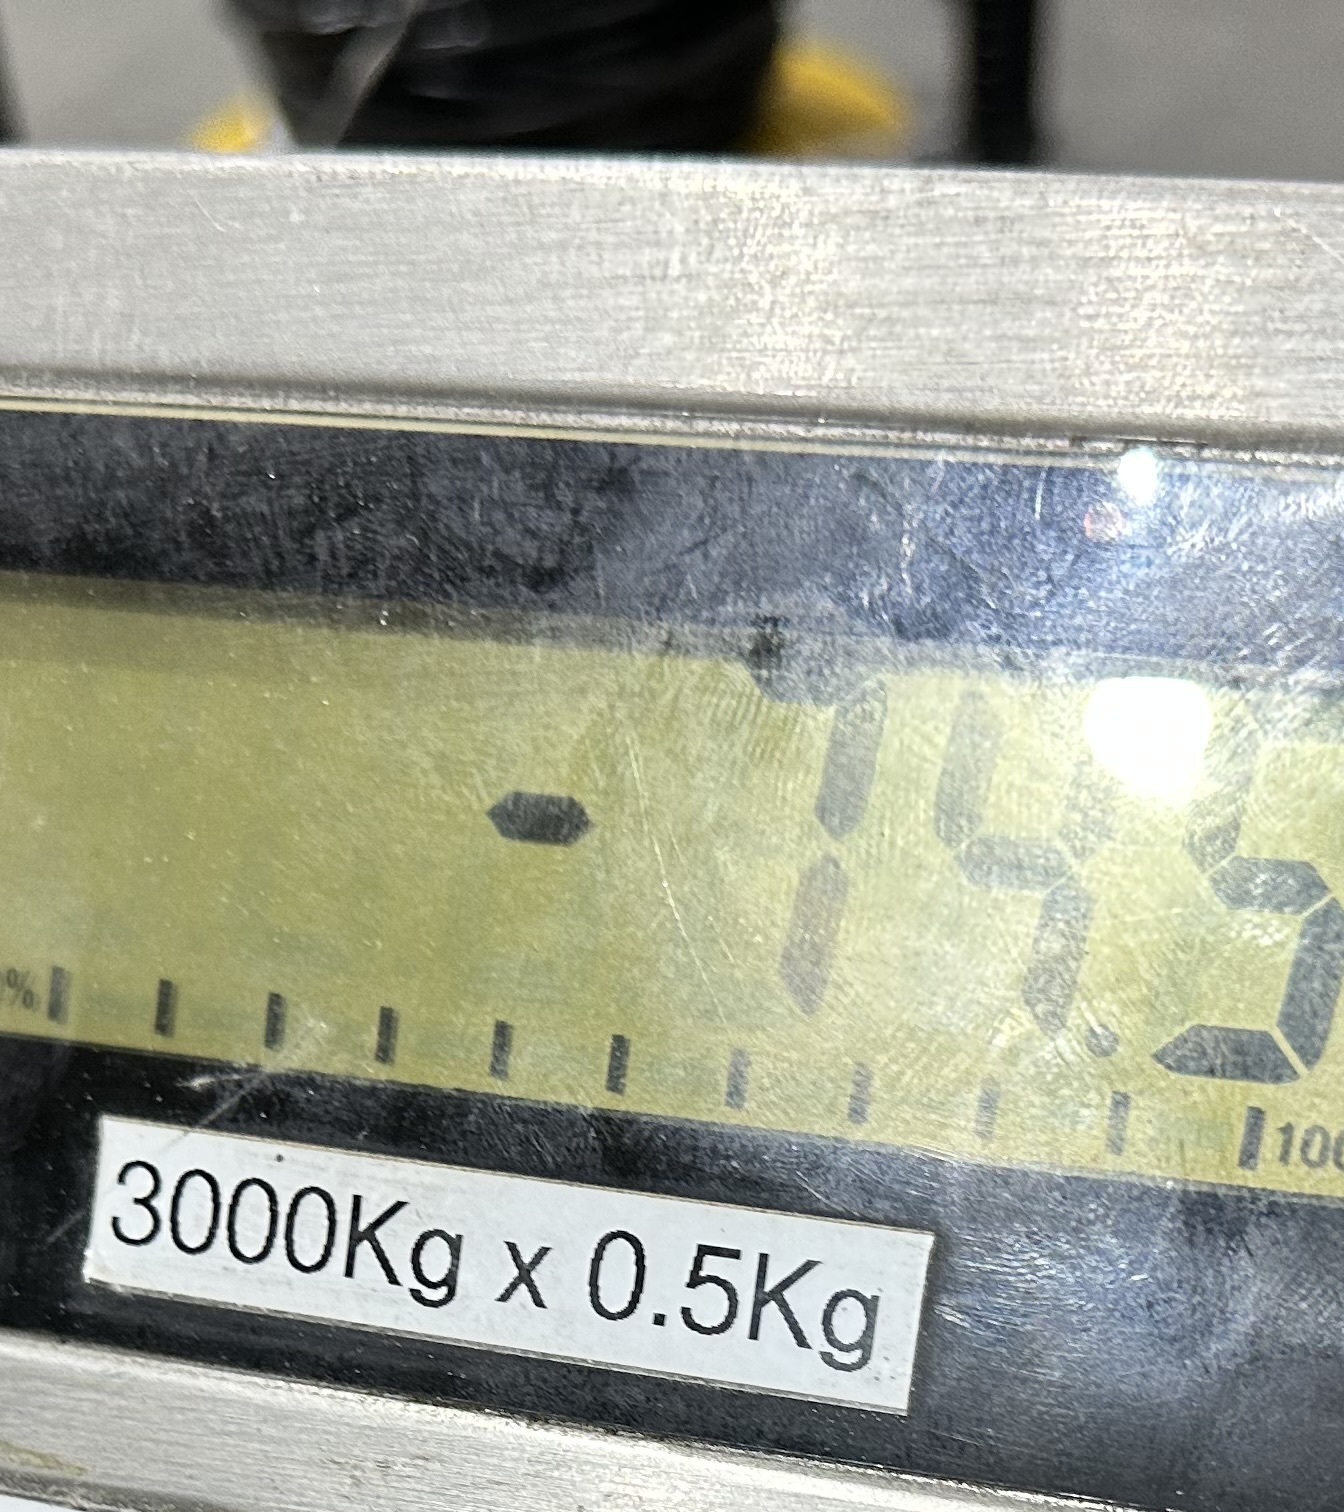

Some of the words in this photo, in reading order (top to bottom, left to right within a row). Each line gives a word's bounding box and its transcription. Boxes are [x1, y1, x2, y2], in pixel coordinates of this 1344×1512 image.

[109, 1158, 463, 1310] 3000Kg
[495, 1239, 553, 1310] x
[588, 1229, 882, 1372] 0.5Kg
